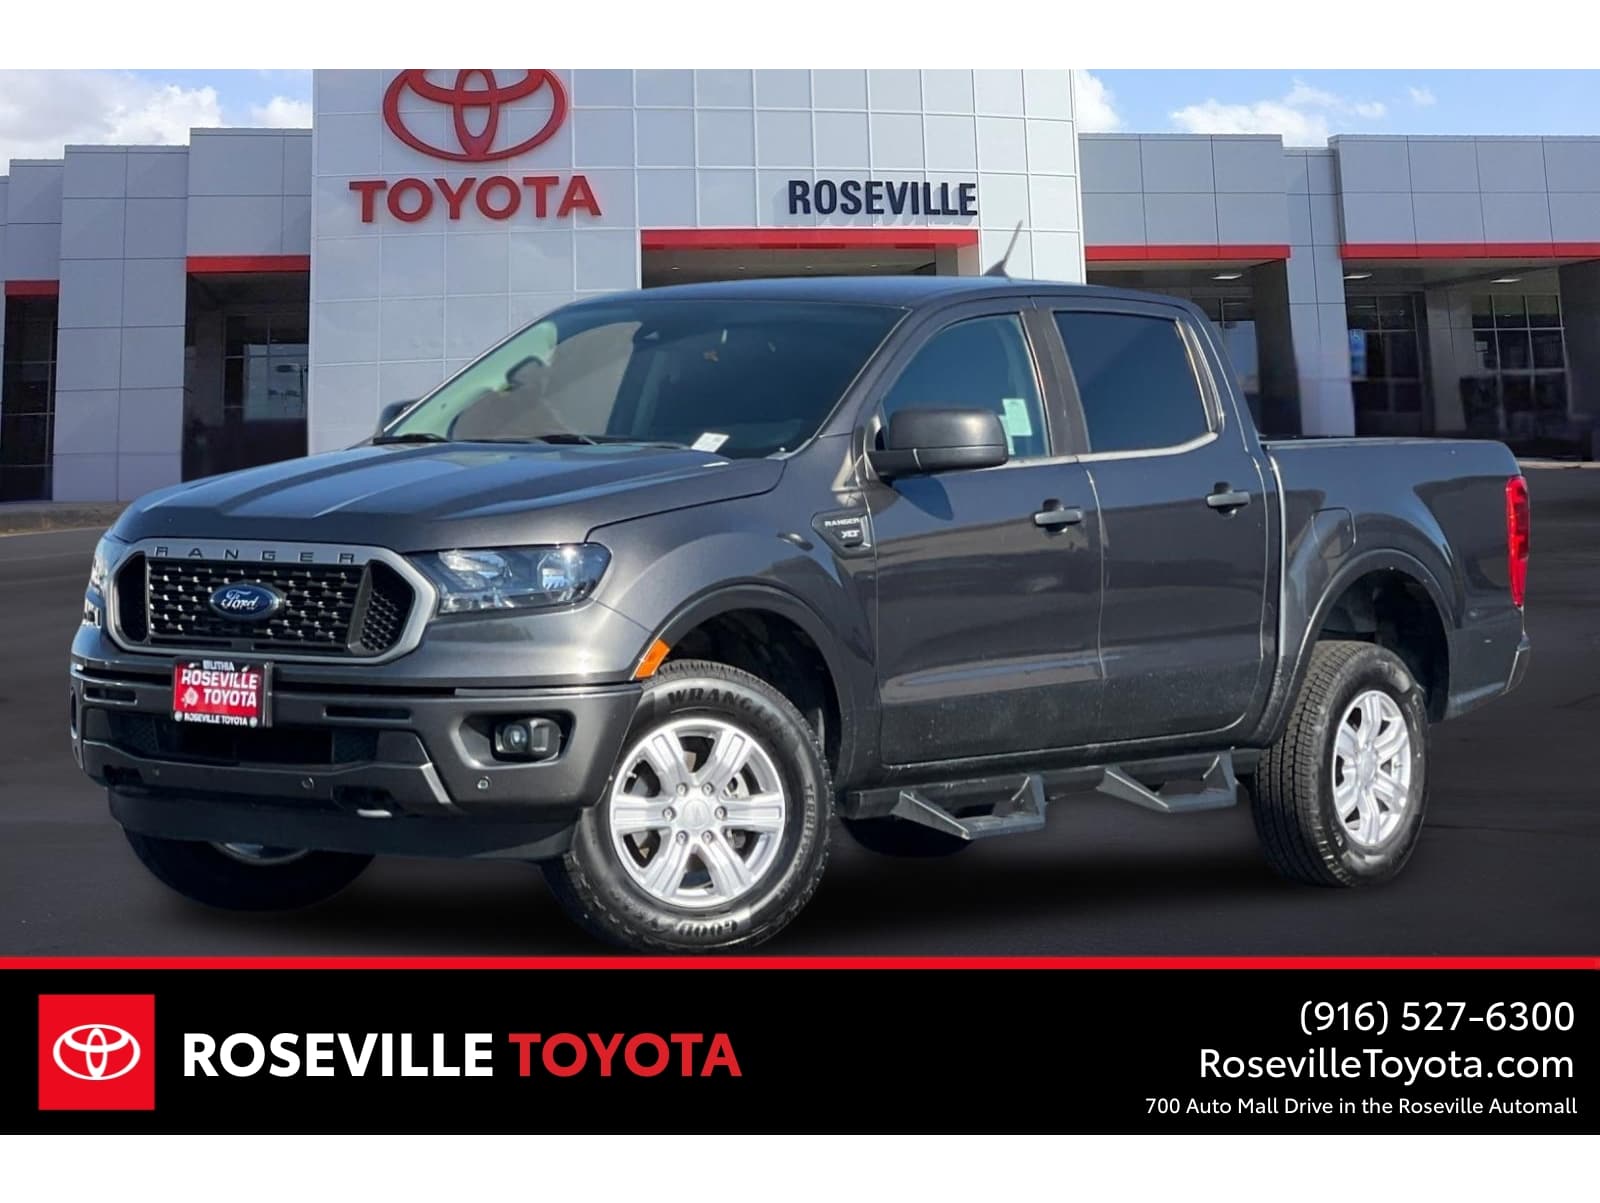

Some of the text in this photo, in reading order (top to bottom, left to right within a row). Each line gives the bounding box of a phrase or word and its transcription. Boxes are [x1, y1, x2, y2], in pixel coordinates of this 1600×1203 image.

[349, 175, 602, 222] TOYOTA
[788, 179, 978, 216] ROSEVILLE
[154, 545, 355, 564] RANGER
[220, 589, 259, 609] Ford
[182, 669, 258, 689] ROSEVILLE
[203, 689, 256, 707] TOYOTA
[184, 713, 248, 726] ROSEVILLE TOYOTA
